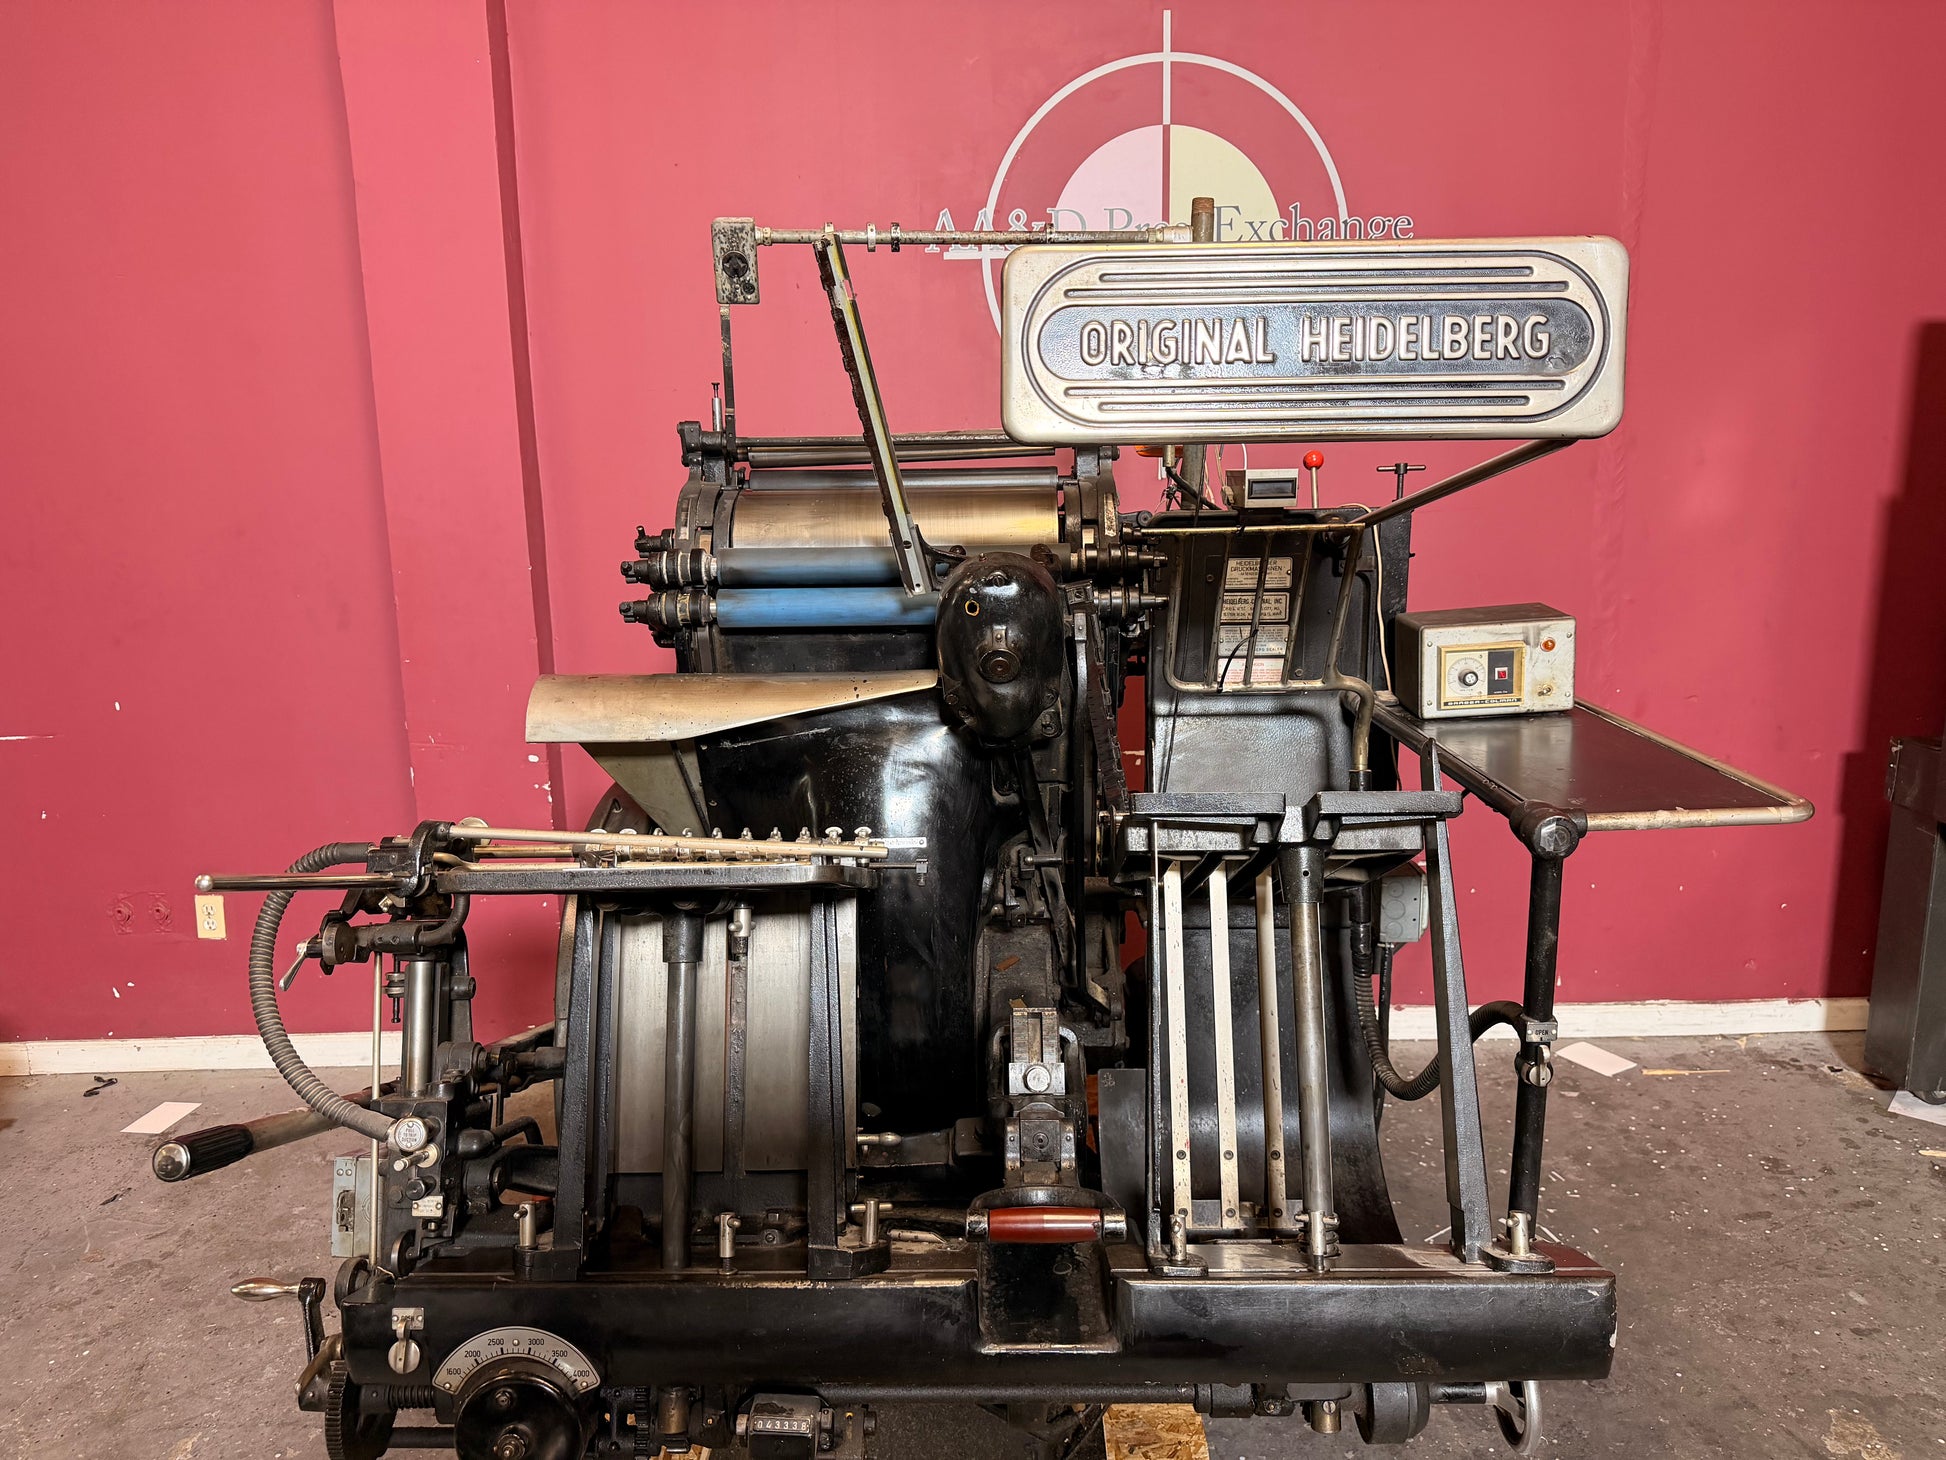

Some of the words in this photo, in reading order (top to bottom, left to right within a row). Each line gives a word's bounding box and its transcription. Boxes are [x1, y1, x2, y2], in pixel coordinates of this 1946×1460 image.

[1080, 317, 1276, 367] ORIGINAL
[1301, 314, 1550, 362] HEIDELBERG
[464, 1350, 481, 1358] 2000
[487, 1338, 505, 1346] 2500
[528, 1338, 545, 1346] 3000
[551, 1350, 568, 1358] 3500
[573, 1370, 590, 1378] 4000
